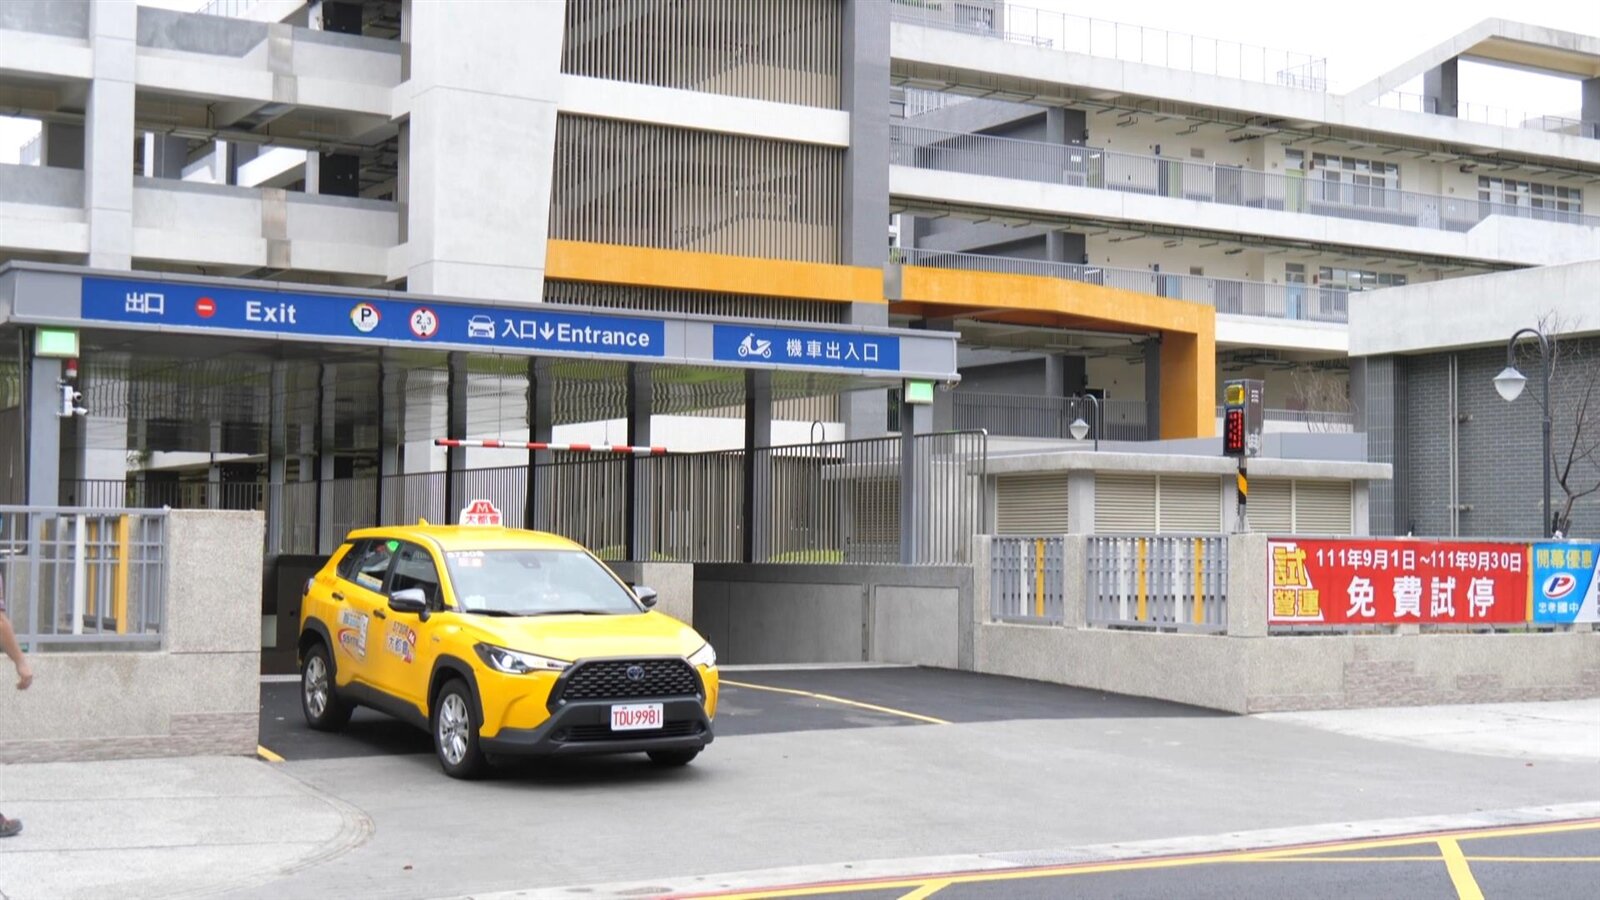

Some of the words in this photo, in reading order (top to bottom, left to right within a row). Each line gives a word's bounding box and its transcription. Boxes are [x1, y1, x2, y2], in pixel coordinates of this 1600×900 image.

[125, 292, 165, 315] 出口
[246, 301, 296, 324] Exit
[361, 307, 372, 322] P
[502, 319, 536, 340] 入口
[557, 323, 650, 347] Entrance
[786, 338, 878, 362] 機車出入口
[1316, 548, 1415, 571] 111年9月1日
[1273, 588, 1320, 617] 營運
[1346, 575, 1495, 618] 免費試停
[1538, 602, 1579, 614] 忠孝國中
